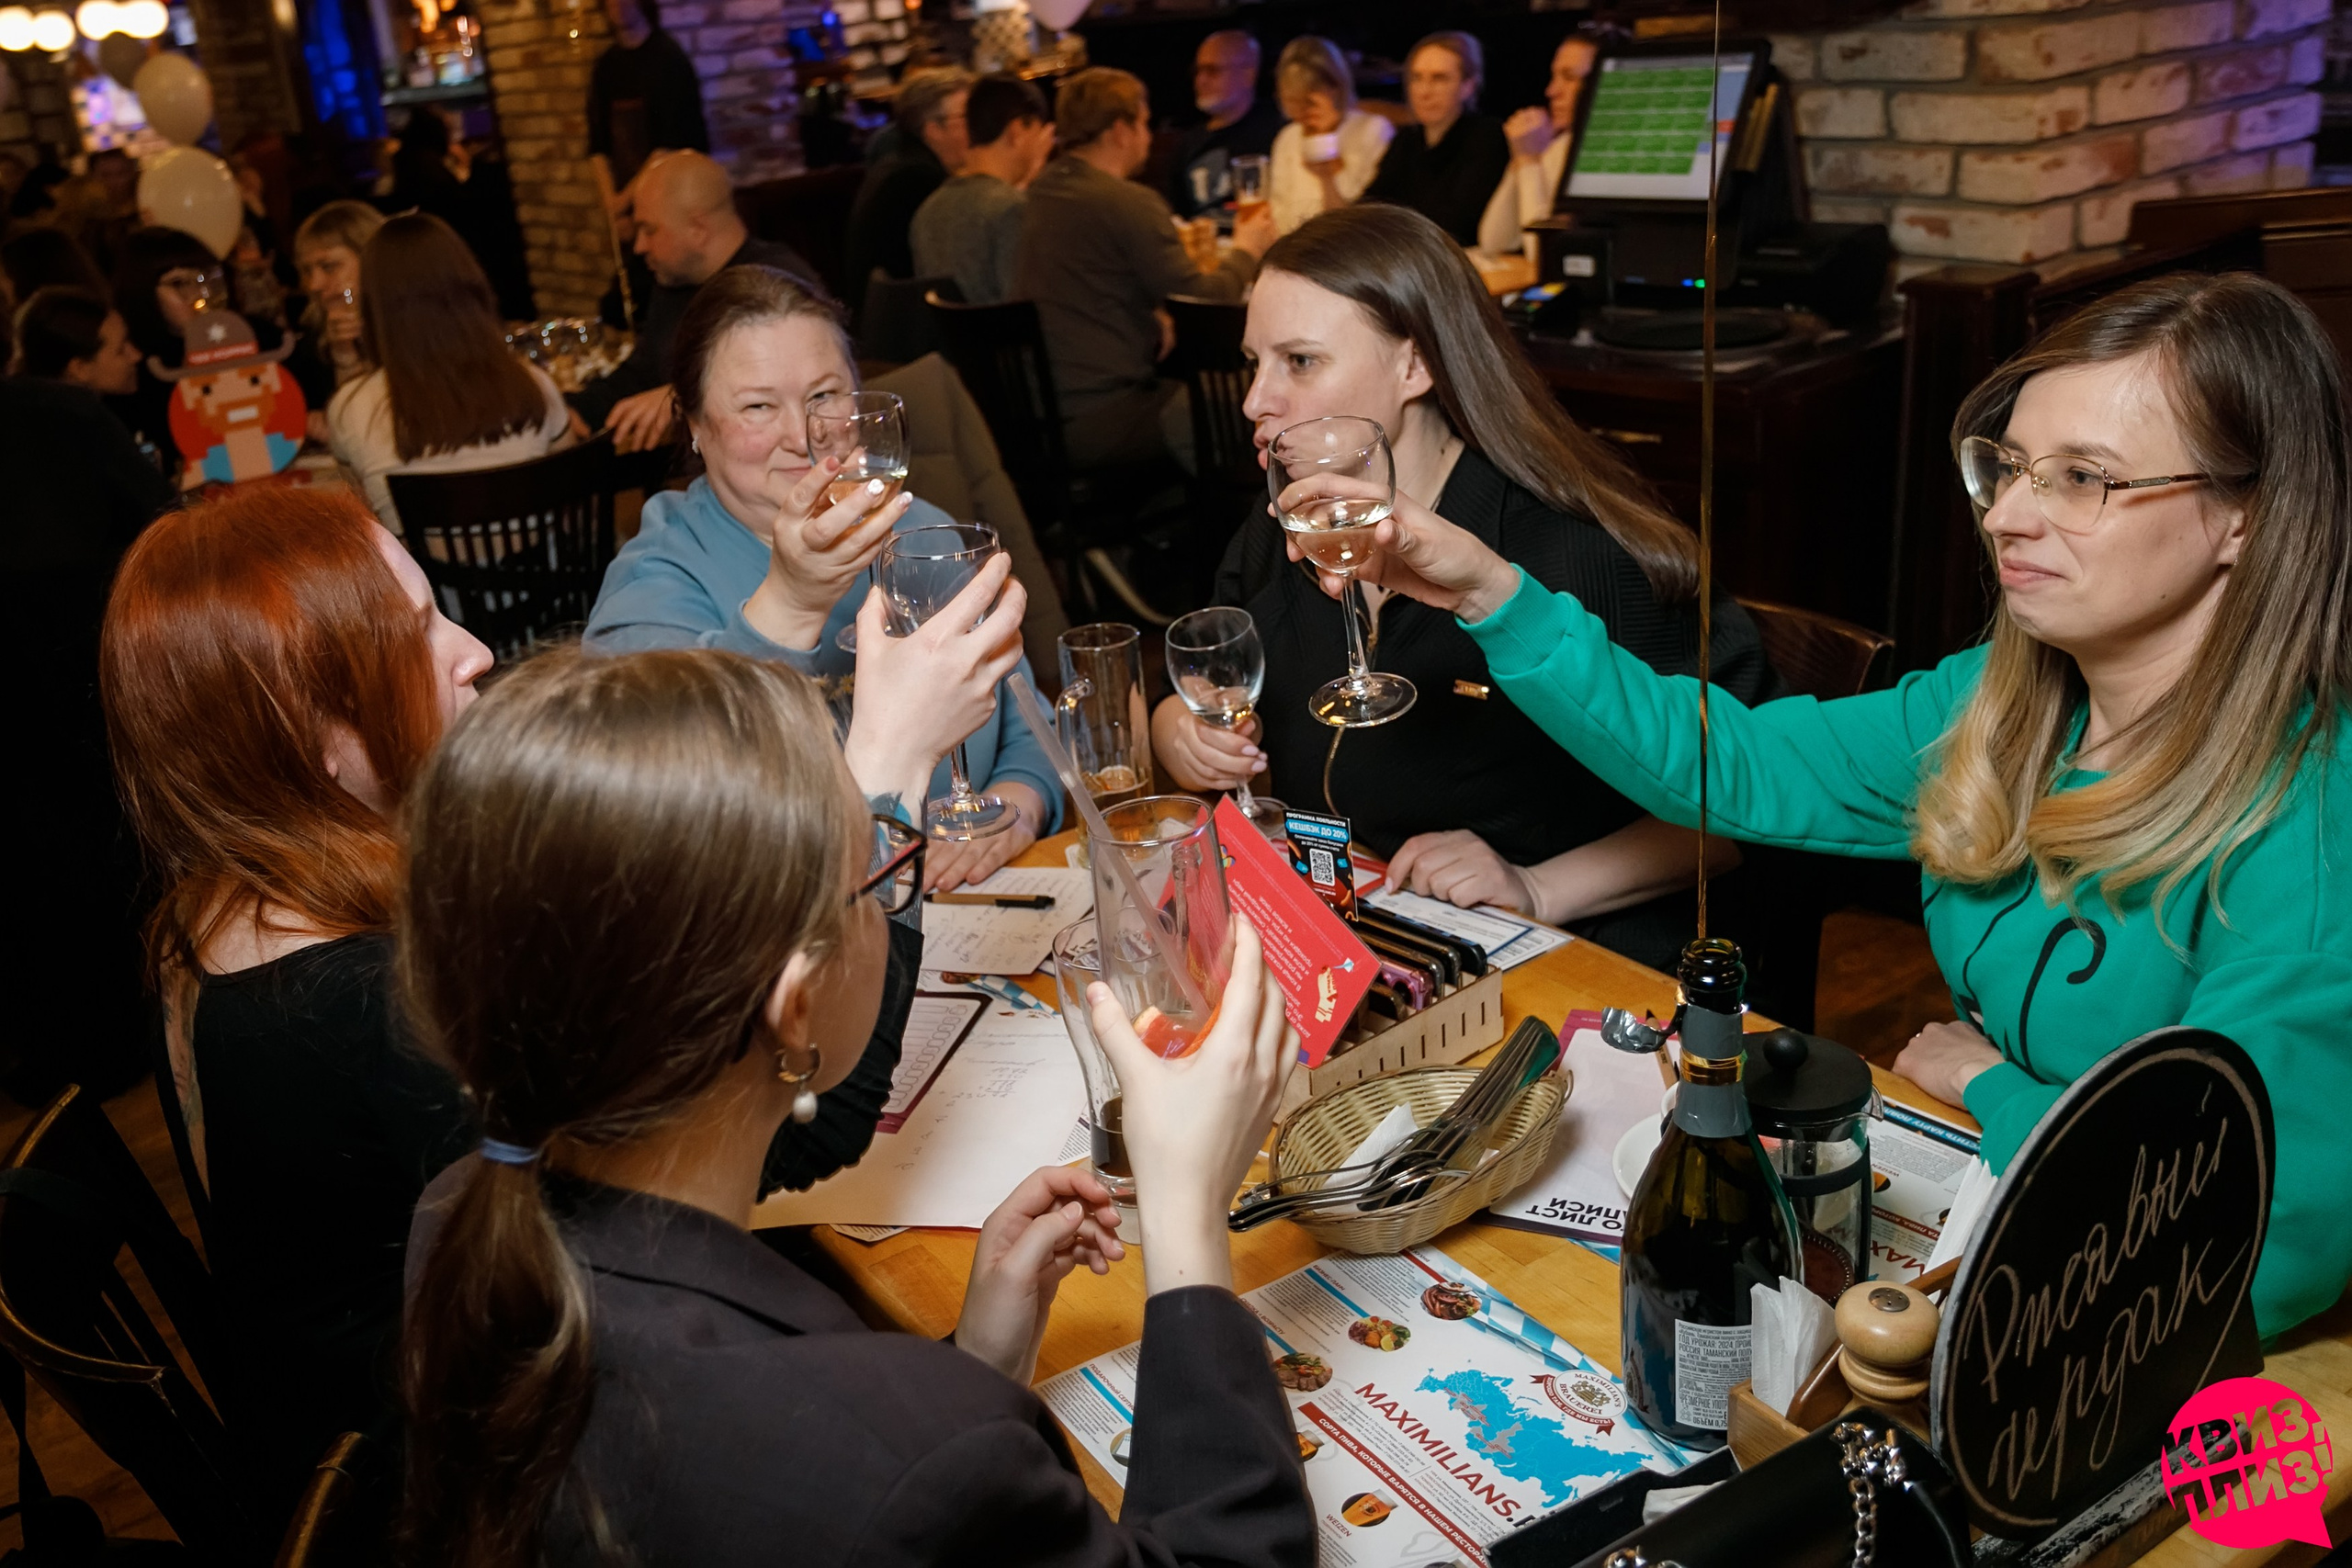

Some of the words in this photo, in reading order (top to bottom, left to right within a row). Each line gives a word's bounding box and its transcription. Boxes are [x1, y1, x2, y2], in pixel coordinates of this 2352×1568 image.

[1289, 822, 1320, 834] КЕШБЭК
[1321, 827, 1332, 836] ДО
[1333, 829, 1347, 840] 20%
[1912, 1118, 1944, 1136] КАРТУ
[1871, 1163, 1900, 1177] WEIZEN
[1525, 1205, 1597, 1225] ЛИСТ
[1549, 1198, 1627, 1220] ПИСИ
[1871, 1240, 1926, 1275] MAX
[1679, 1334, 1690, 1345] ГОД
[1690, 1337, 1717, 1348] УРОЖАЯ:
[1703, 1348, 1737, 1358] ТАМАНСКИЙ
[1090, 1363, 1121, 1394] ПОДАРОЧНЫЙ
[1987, 1237, 2249, 1502] чердак
[1559, 1383, 1603, 1415] BRAUEREI
[1679, 1393, 1710, 1408] ЧРЕЗМЕРНОЕ
[1712, 1399, 1727, 1410] УПОТР
[1576, 1414, 1589, 1422] МЫ
[1693, 1417, 1713, 1426] ОБЪЕМ
[1319, 1418, 1340, 1437] СОРТА
[1338, 1433, 1358, 1454] ПИВА,
[1357, 1450, 1390, 1479] КОТОРЫЕ
[1388, 1475, 1421, 1506] ВАРЯТСЯ
[1417, 1501, 1425, 1511] В
[1424, 1507, 1454, 1534] НАШЕМ
[1326, 1514, 1352, 1537] WEIZEN
